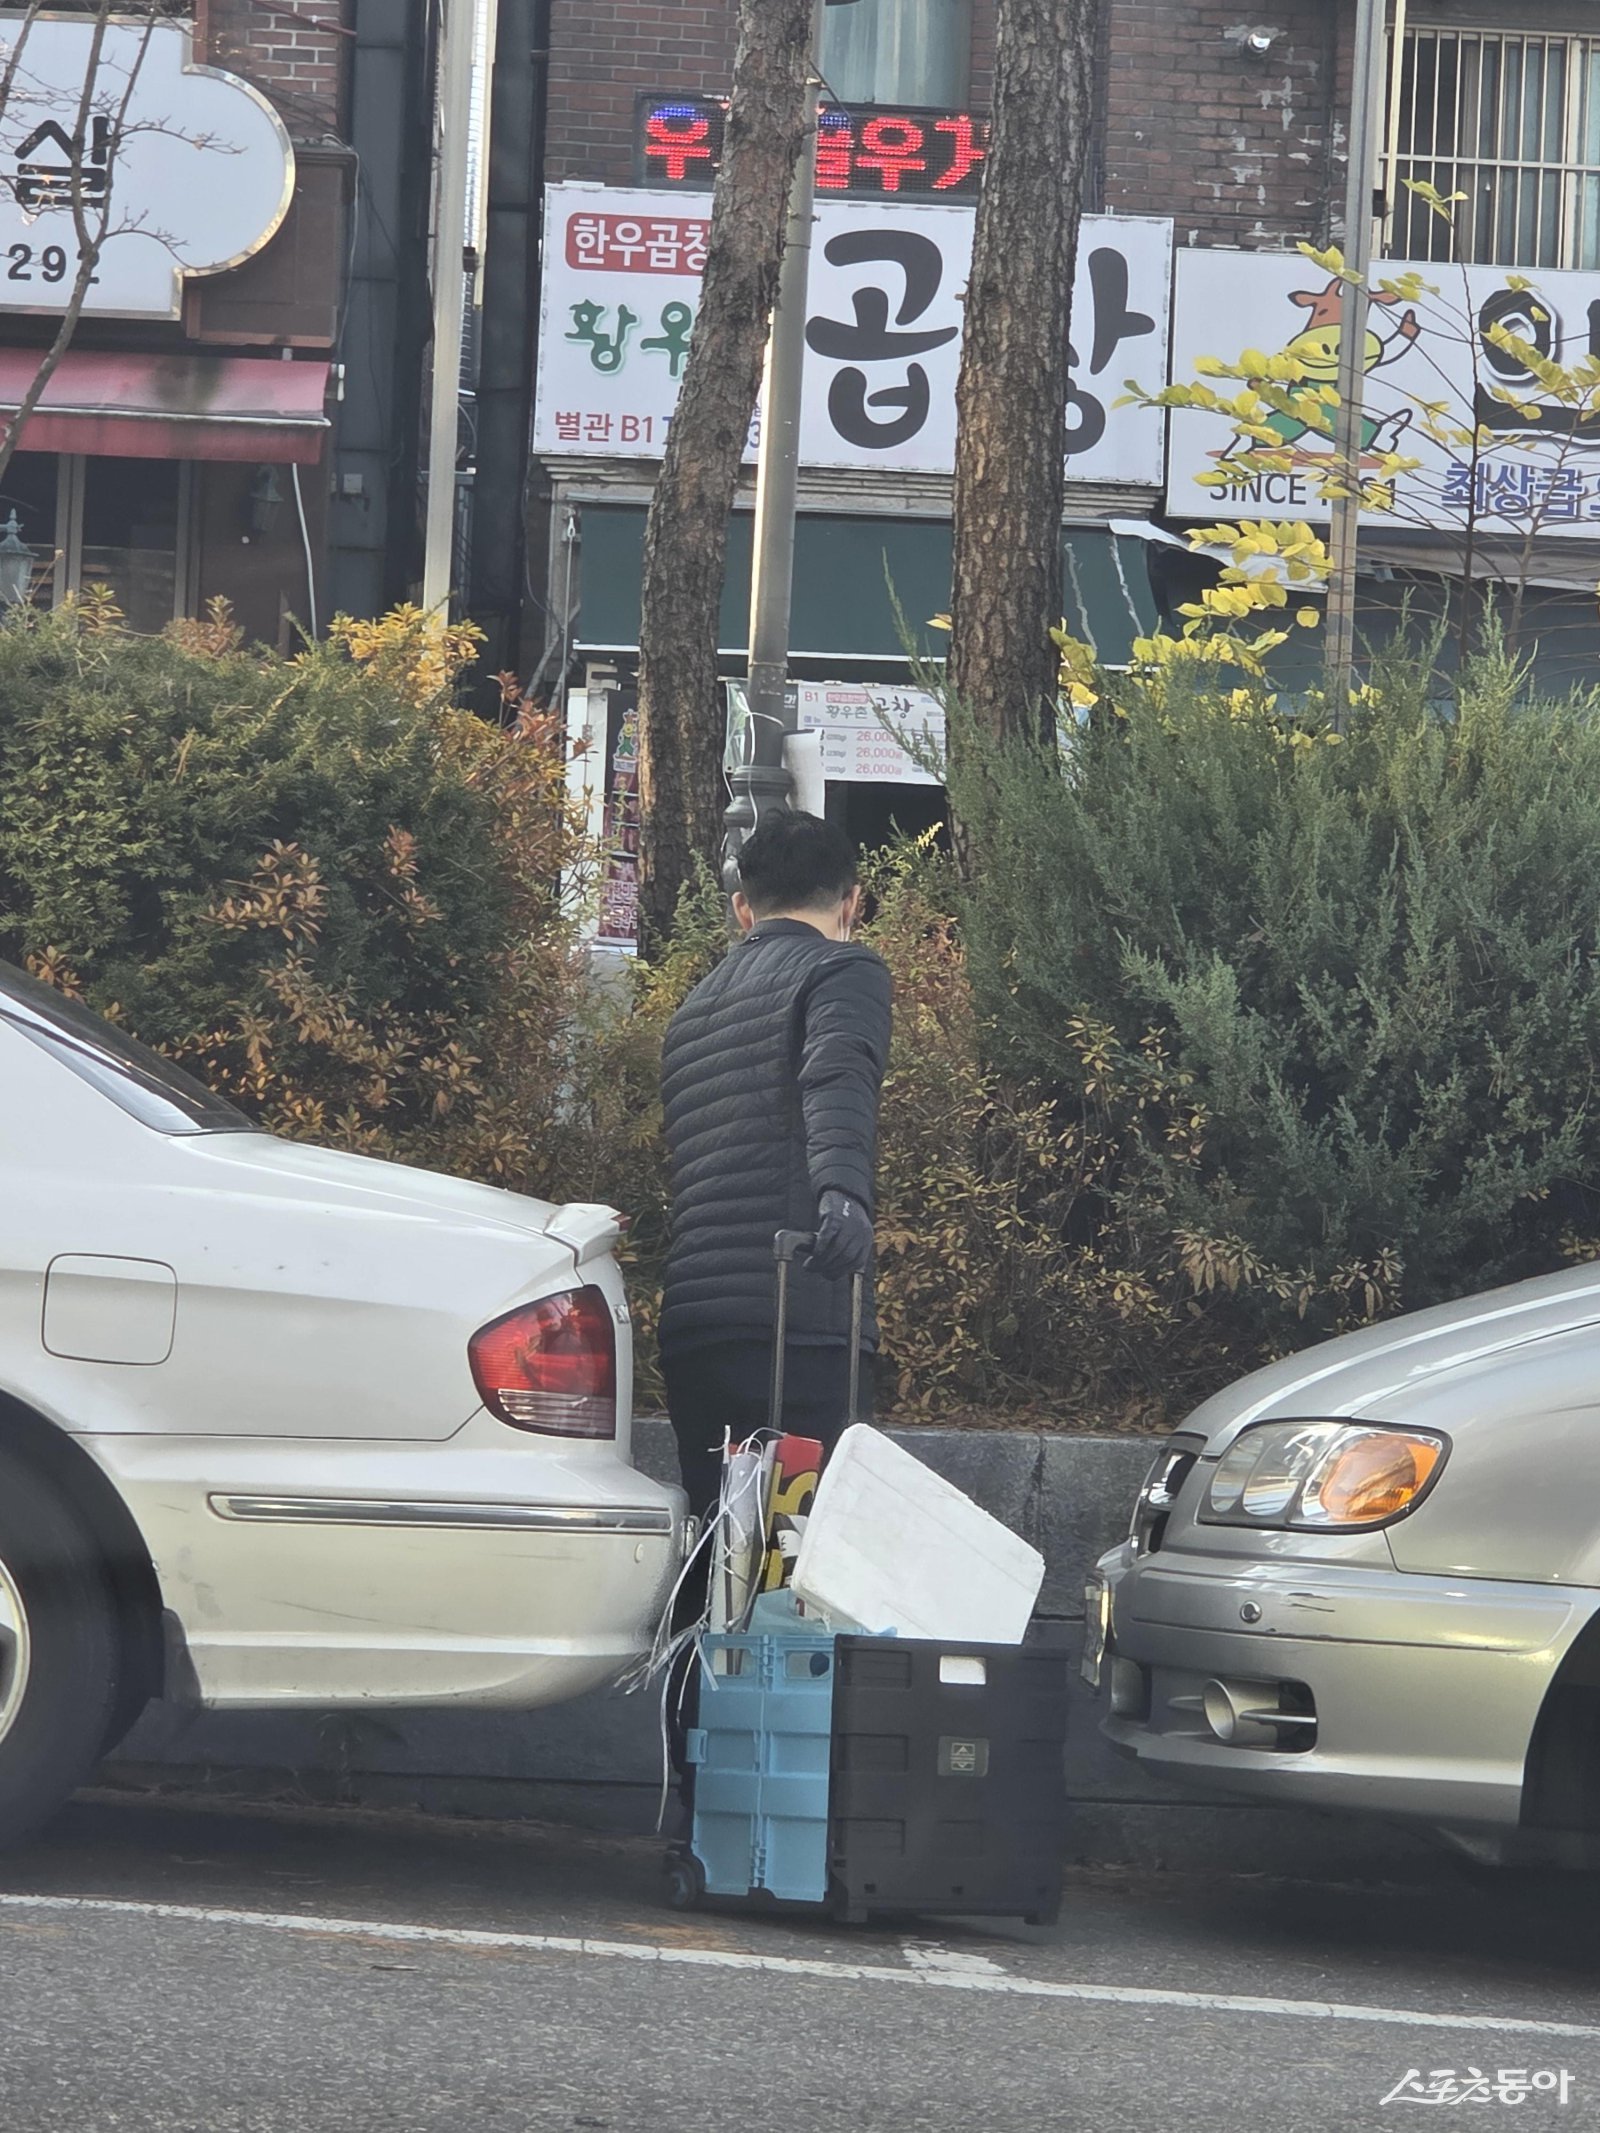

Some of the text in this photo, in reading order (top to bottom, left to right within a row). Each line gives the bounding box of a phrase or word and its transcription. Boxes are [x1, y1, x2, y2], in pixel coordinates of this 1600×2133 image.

[555, 411, 614, 442] 별관
[621, 415, 652, 443] B1
[1210, 469, 1307, 506] SINCE
[1442, 461, 1600, 519] 최상급
[804, 691, 819, 701] B1
